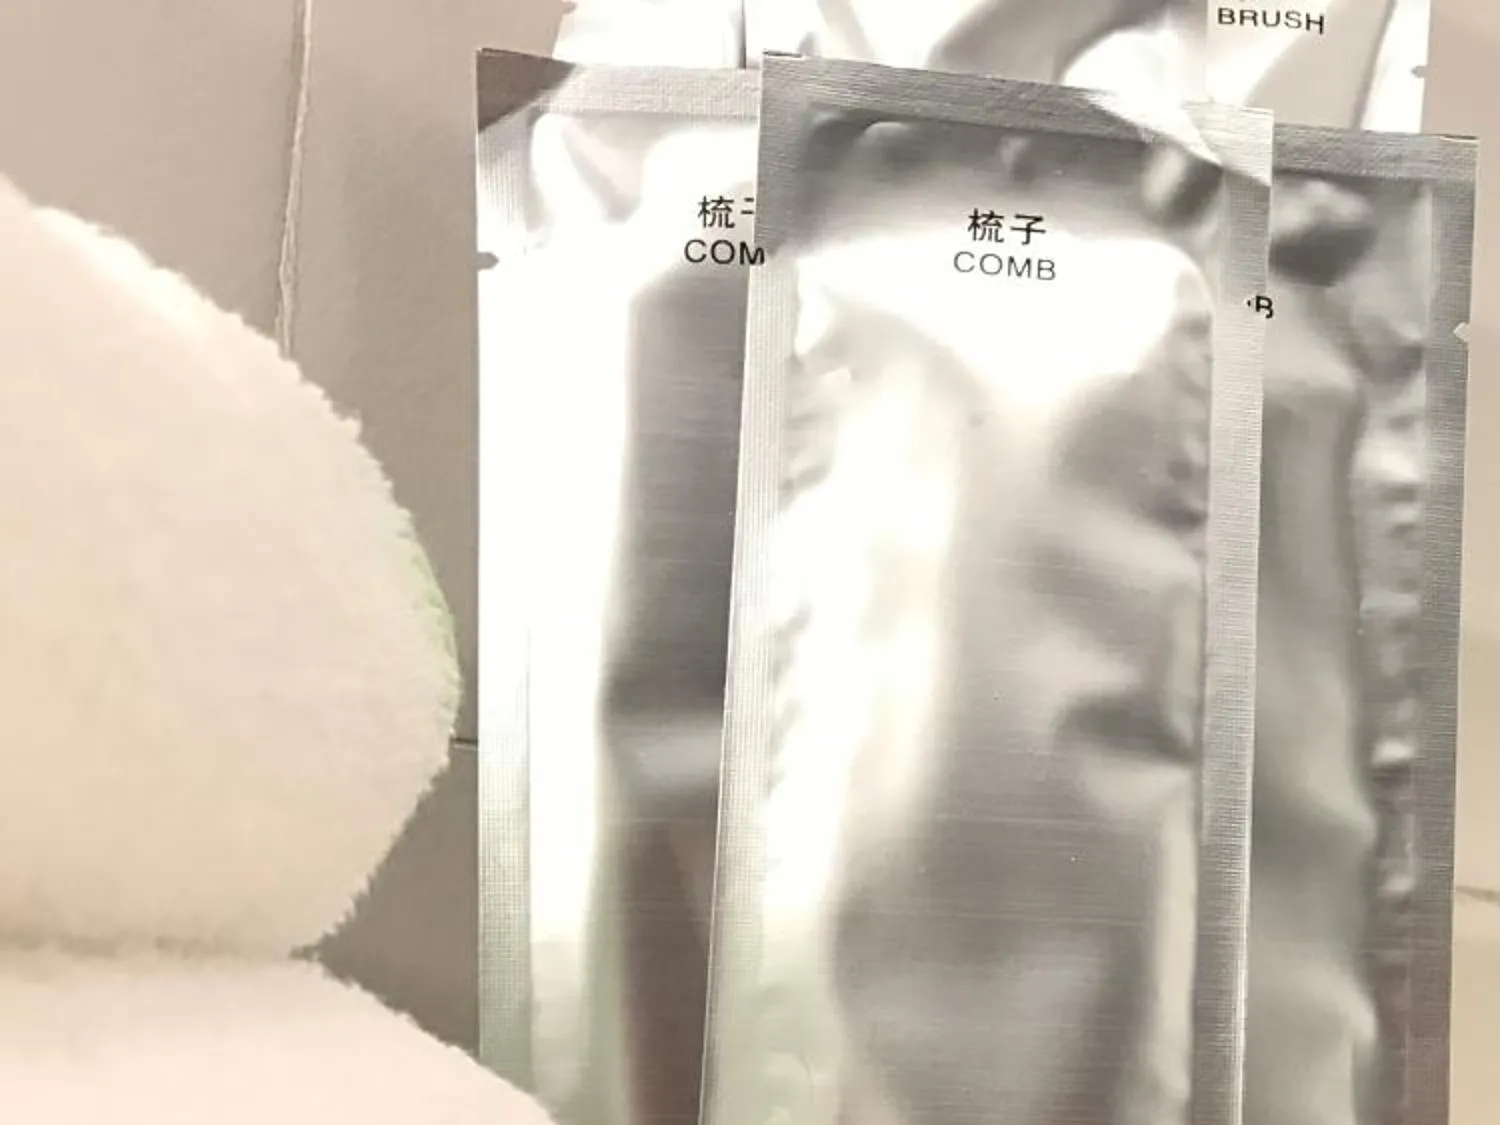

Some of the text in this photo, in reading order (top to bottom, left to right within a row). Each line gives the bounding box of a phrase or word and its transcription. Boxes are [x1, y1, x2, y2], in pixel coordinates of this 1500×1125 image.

[1217, 6, 1325, 35] BRUSH
[967, 207, 1047, 245] 梳子
[953, 250, 1056, 281] COMB
